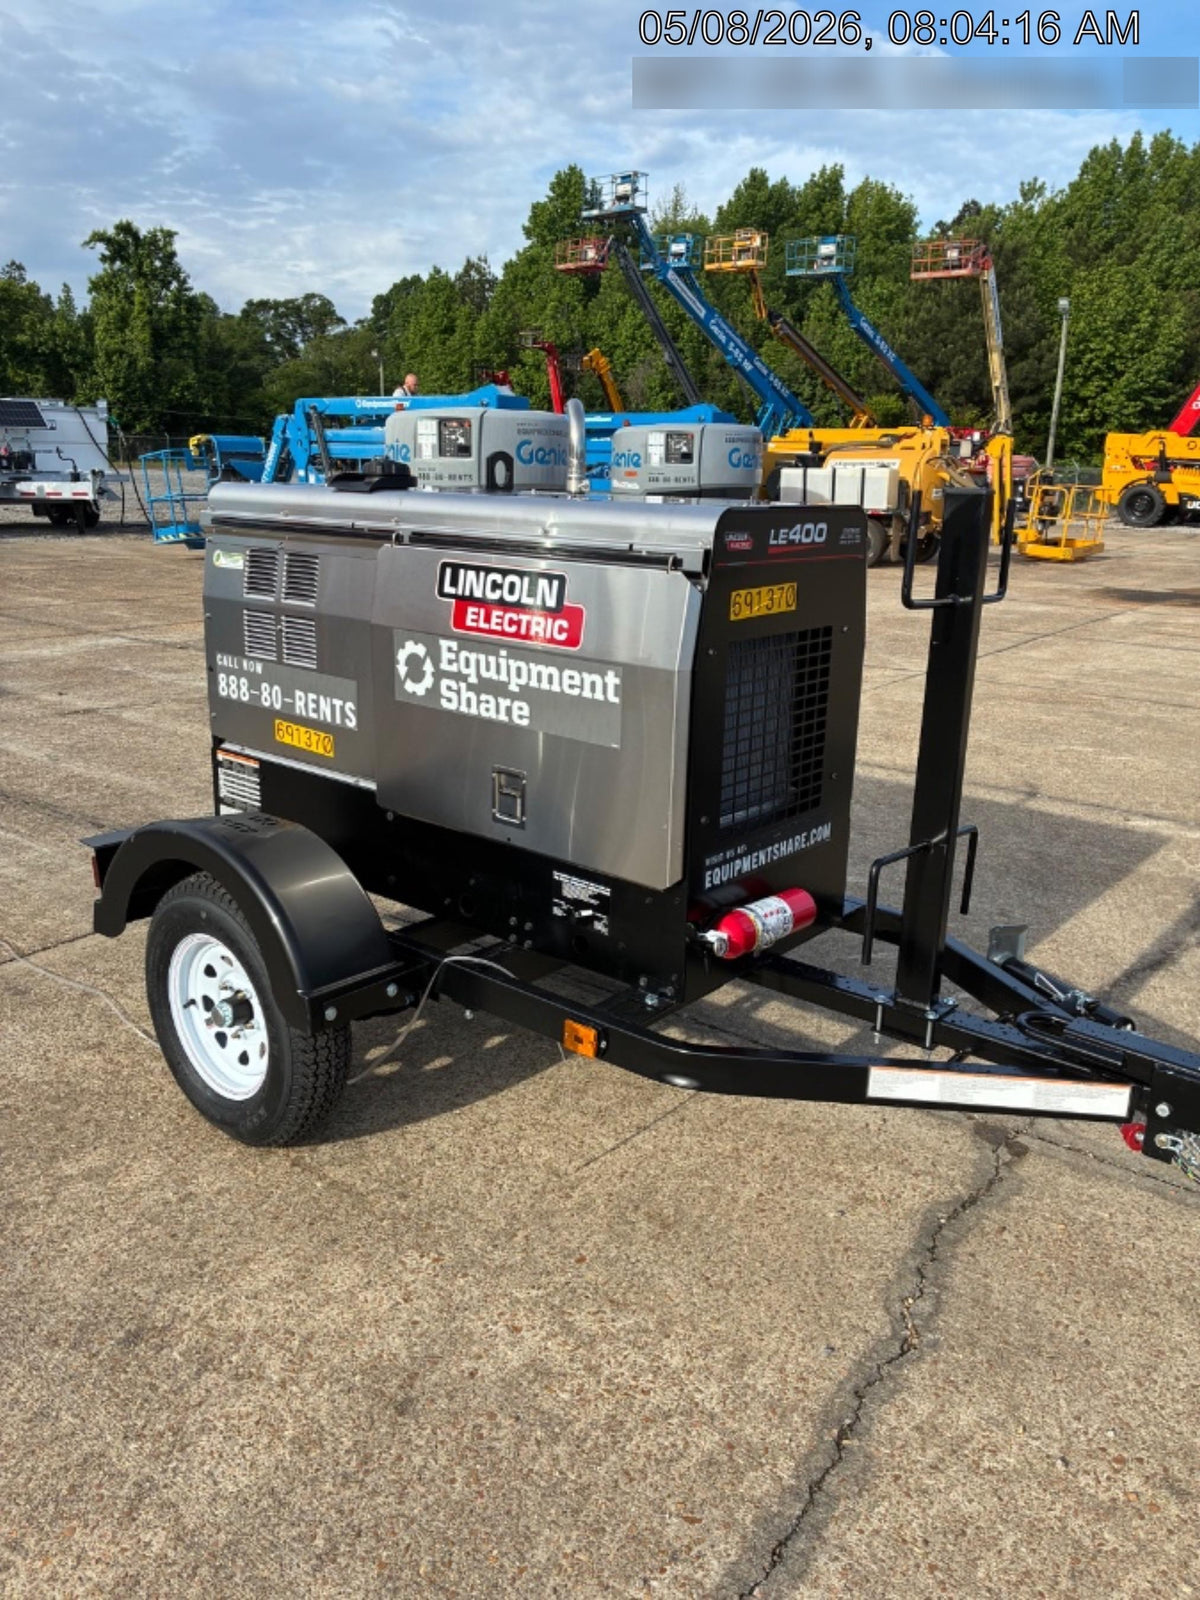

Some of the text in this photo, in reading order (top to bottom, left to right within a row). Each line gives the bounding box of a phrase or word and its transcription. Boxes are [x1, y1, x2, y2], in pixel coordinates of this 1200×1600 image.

[769, 522, 827, 545] LE400
[442, 566, 560, 609] LINCOLN
[731, 584, 797, 618] 691370
[465, 608, 570, 642] ELECTRIC
[216, 653, 264, 675] CALL NOW
[439, 639, 621, 704] Equipment
[217, 672, 358, 729] 888-80-RENTS
[440, 679, 531, 727] Share
[275, 720, 334, 755] 691370
[704, 822, 832, 889] EQUIPMENTSHARE.COM
